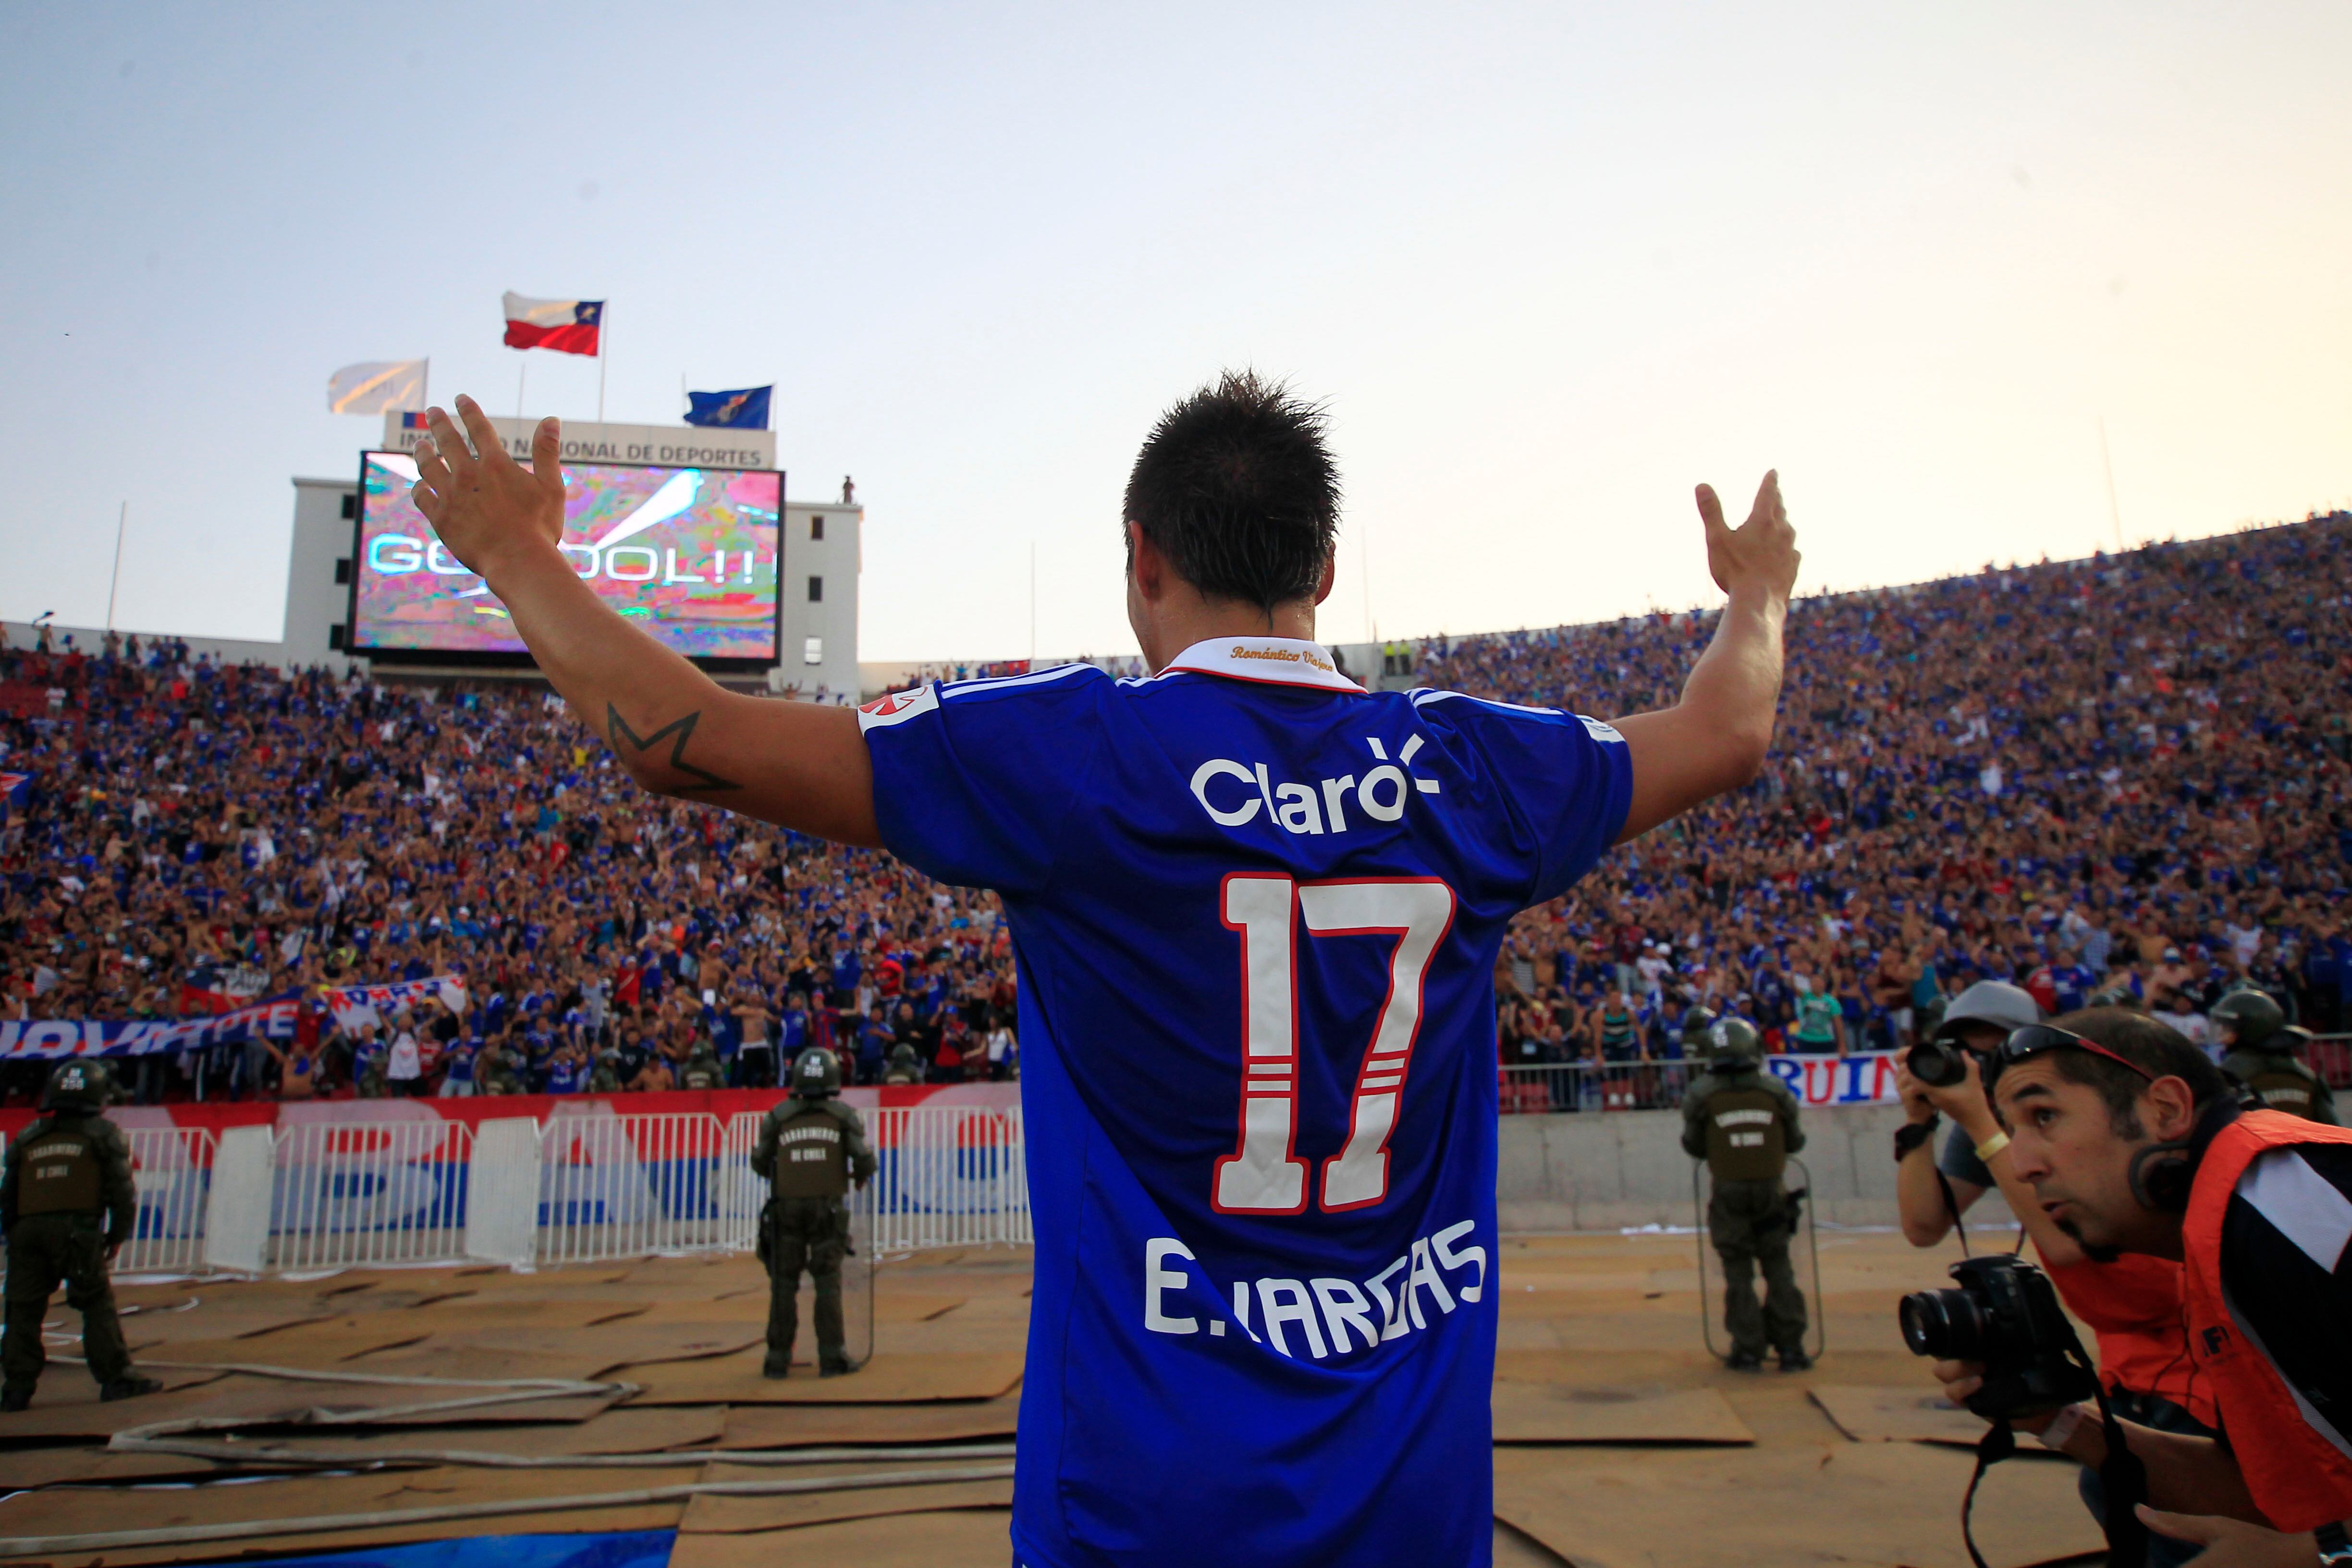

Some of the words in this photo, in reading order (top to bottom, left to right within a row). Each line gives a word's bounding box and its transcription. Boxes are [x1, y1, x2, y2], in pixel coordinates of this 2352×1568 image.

[514, 438, 620, 459] NIONAL
[627, 444, 654, 461] DE
[660, 446, 761, 466] DEPORTES
[1231, 646, 1300, 662] Romántico
[1190, 759, 1407, 834] Claro
[1210, 871, 1457, 1215] 17
